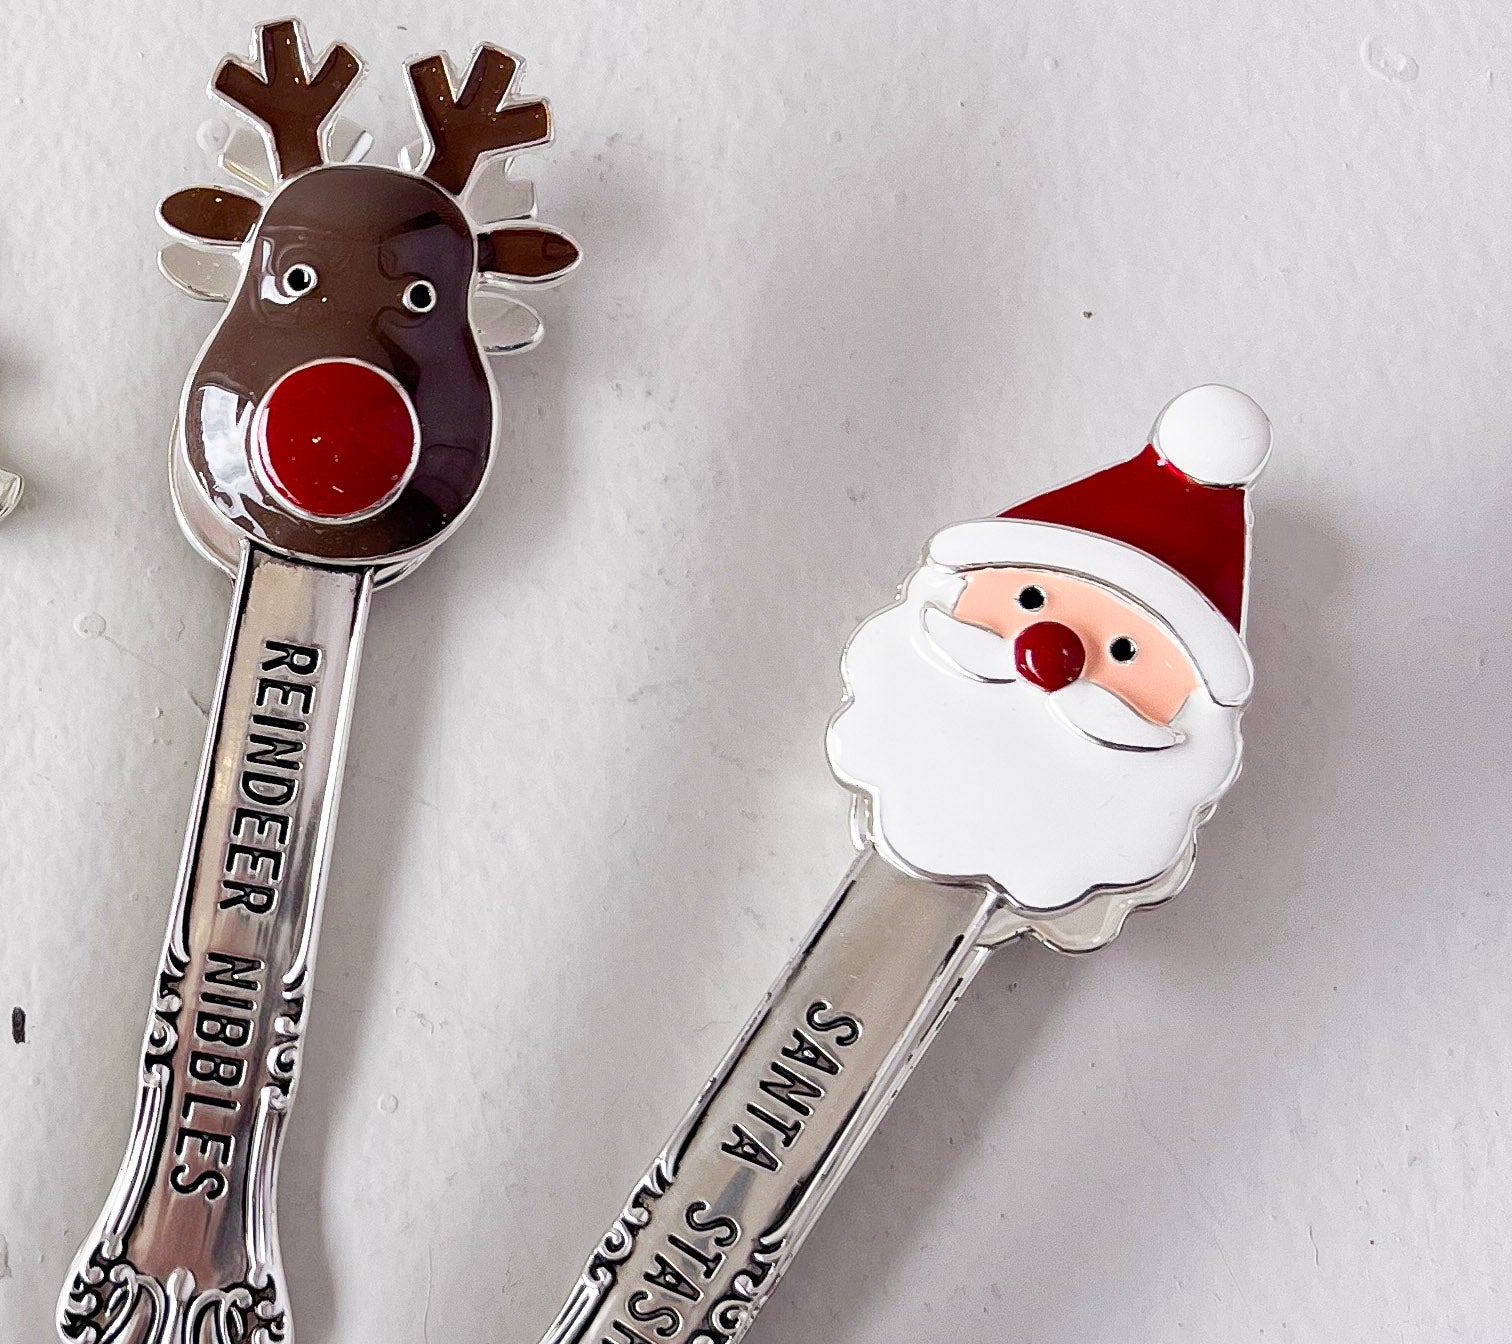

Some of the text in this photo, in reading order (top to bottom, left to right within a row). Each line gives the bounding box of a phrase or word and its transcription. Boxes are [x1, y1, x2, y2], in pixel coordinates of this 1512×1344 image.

[170, 640, 323, 1202] REINDEER NIBBLES
[721, 1000, 862, 1172] SANTA
